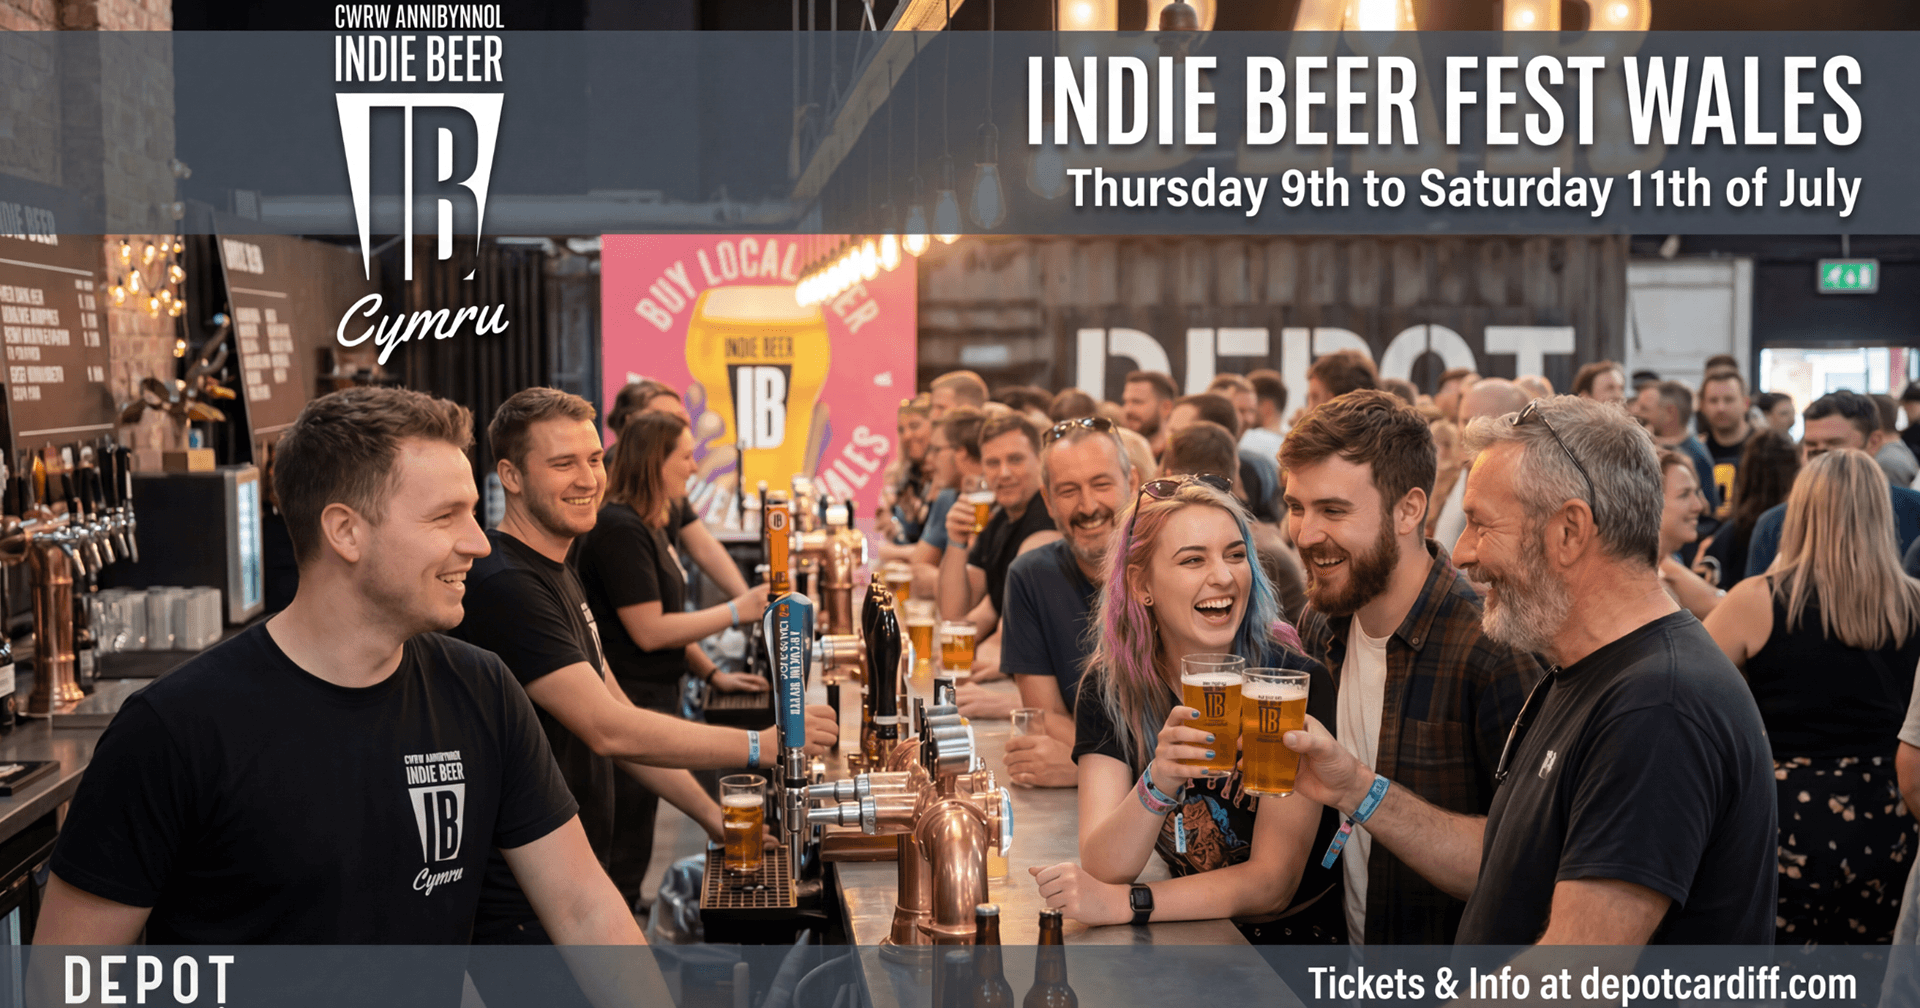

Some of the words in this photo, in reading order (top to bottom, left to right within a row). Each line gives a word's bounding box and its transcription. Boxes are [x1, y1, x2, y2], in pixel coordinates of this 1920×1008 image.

[635, 260, 697, 333] BUY
[697, 237, 798, 286] LOCAL
[826, 282, 879, 334] ER
[736, 366, 786, 449] IB
[1208, 693, 1224, 717] IB
[1261, 708, 1279, 733] IB
[406, 764, 438, 785] INDIE
[439, 762, 465, 782] BEER
[423, 790, 459, 861] IB
[412, 867, 464, 896] Cymru
